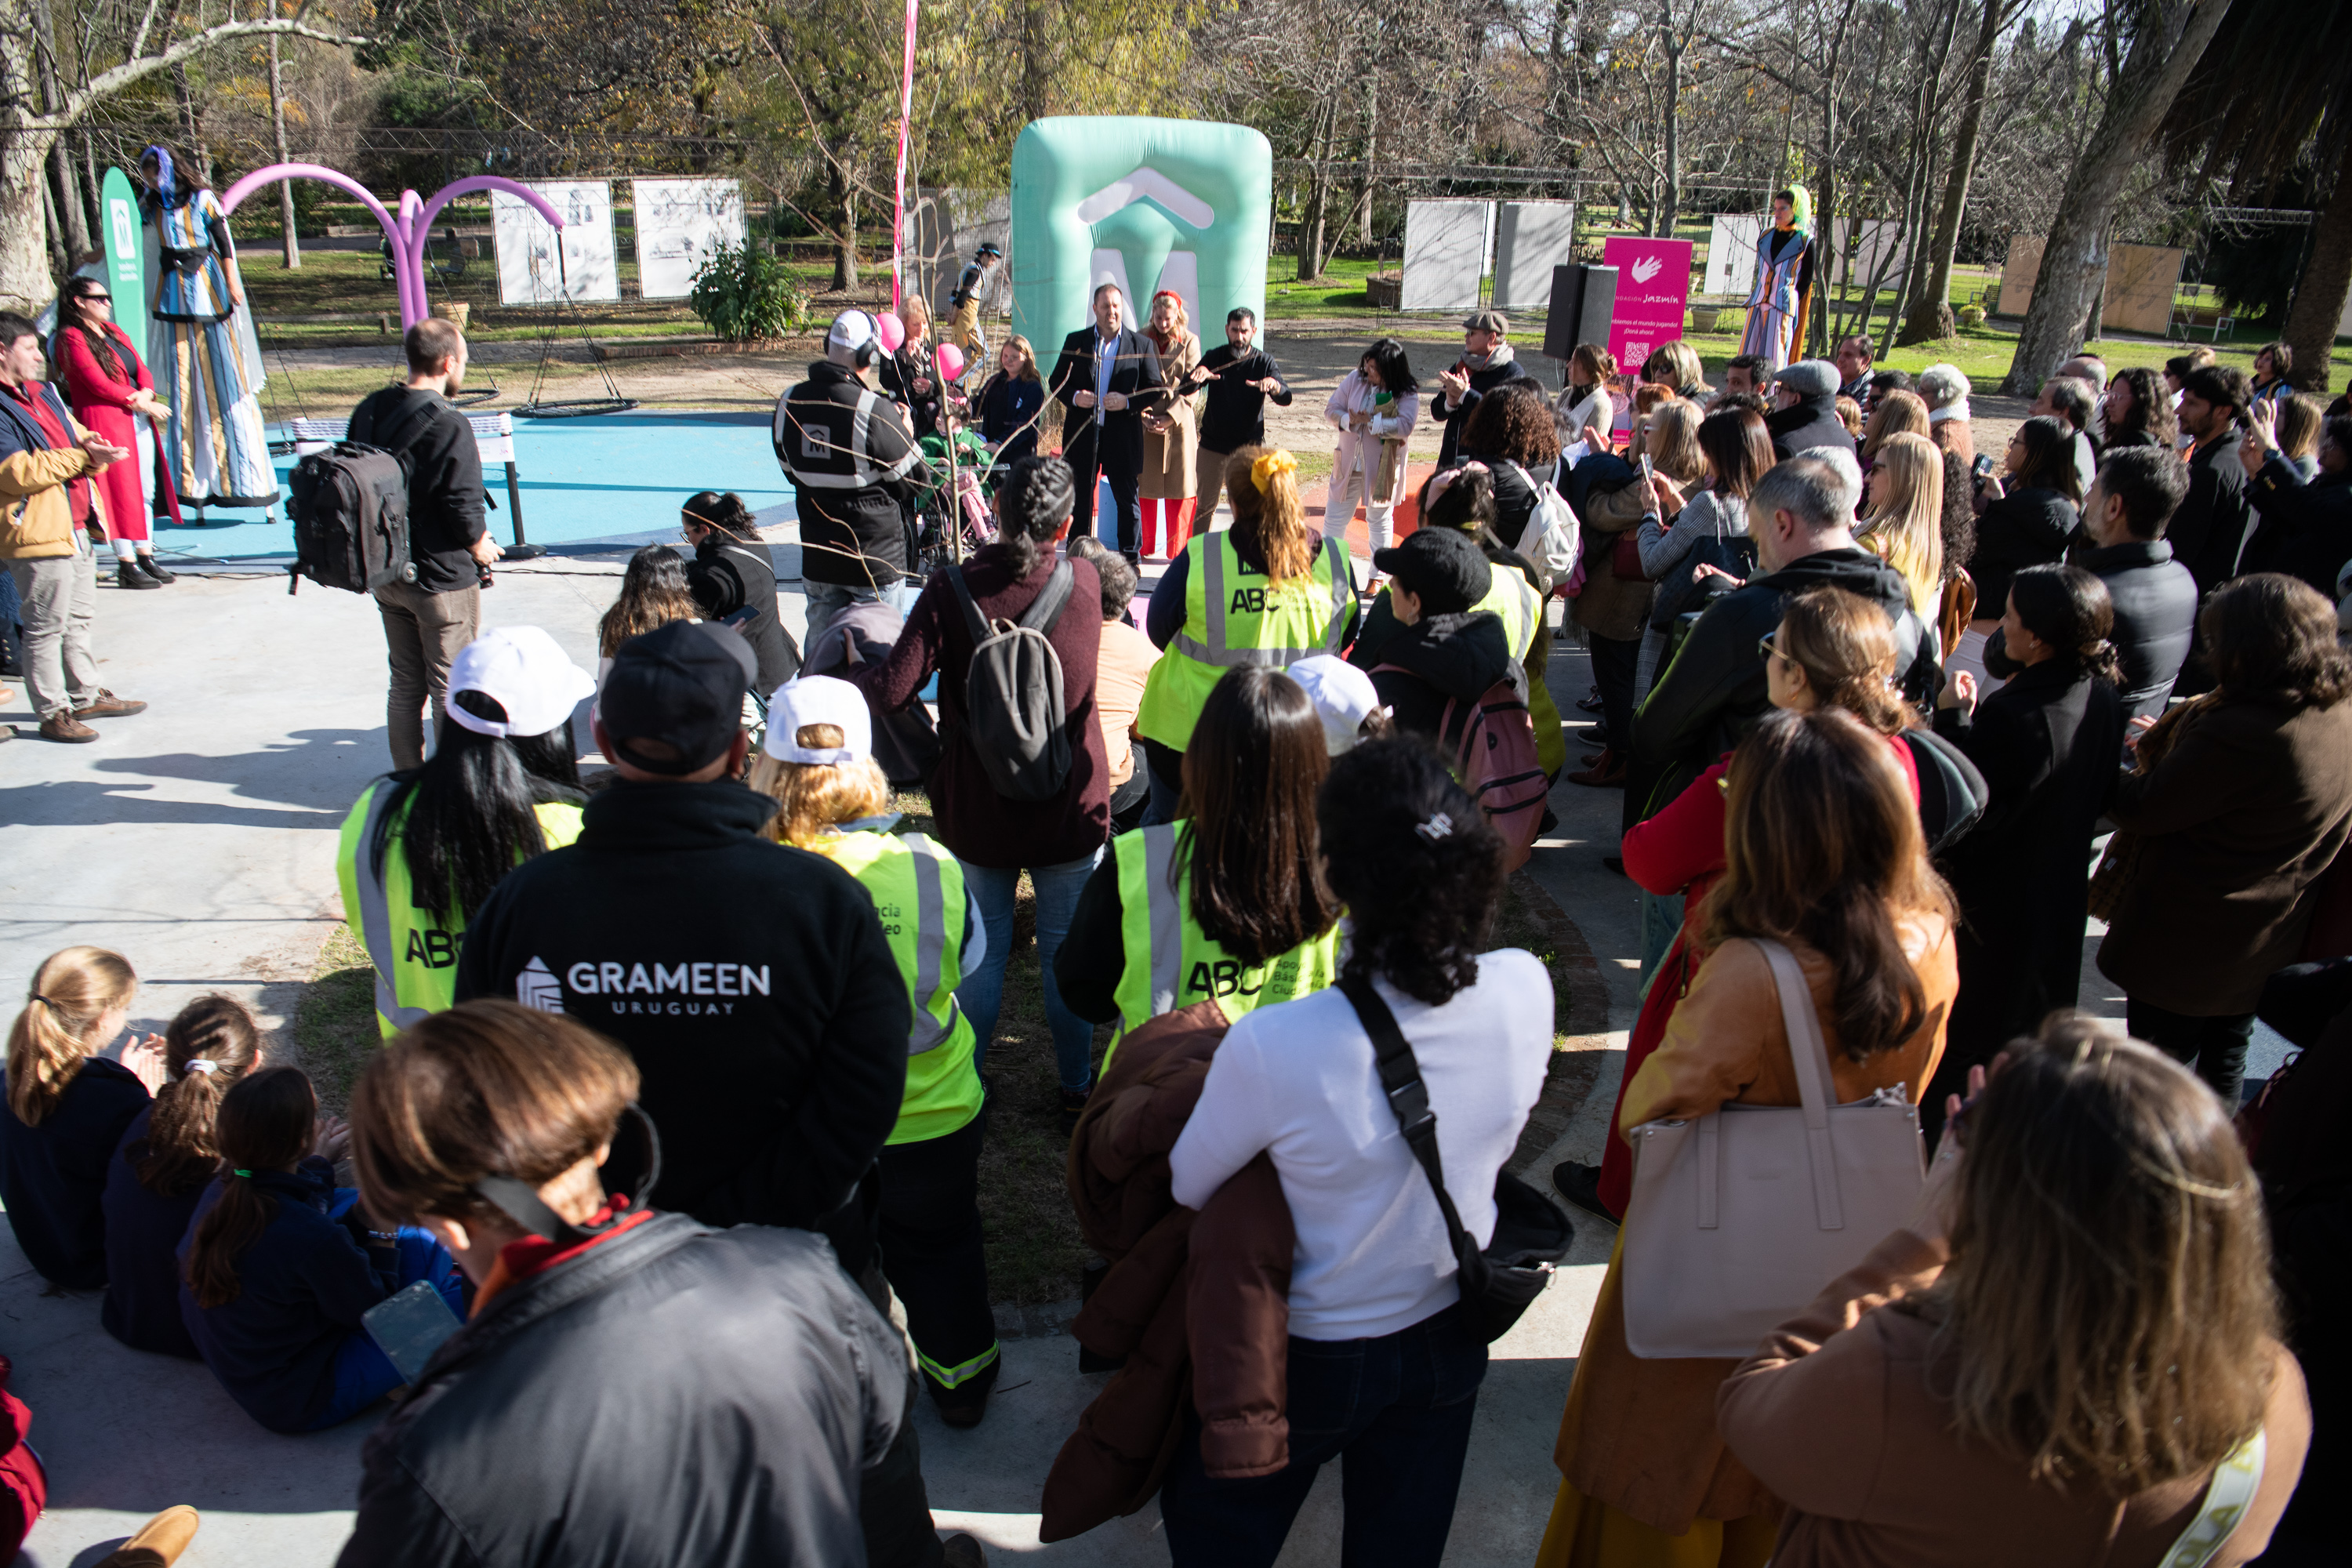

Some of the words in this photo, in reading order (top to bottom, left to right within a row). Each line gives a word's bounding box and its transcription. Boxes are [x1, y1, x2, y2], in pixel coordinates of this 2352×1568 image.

[1642, 293, 1679, 304] Jazmín
[809, 437, 825, 452] M
[1230, 587, 1280, 614] ABC
[874, 902, 901, 917] ncia
[568, 961, 771, 996] GRAMEEN
[1185, 960, 1263, 999] ABC
[1274, 971, 1306, 982] Básic
[612, 1000, 735, 1015] URUGUAY
